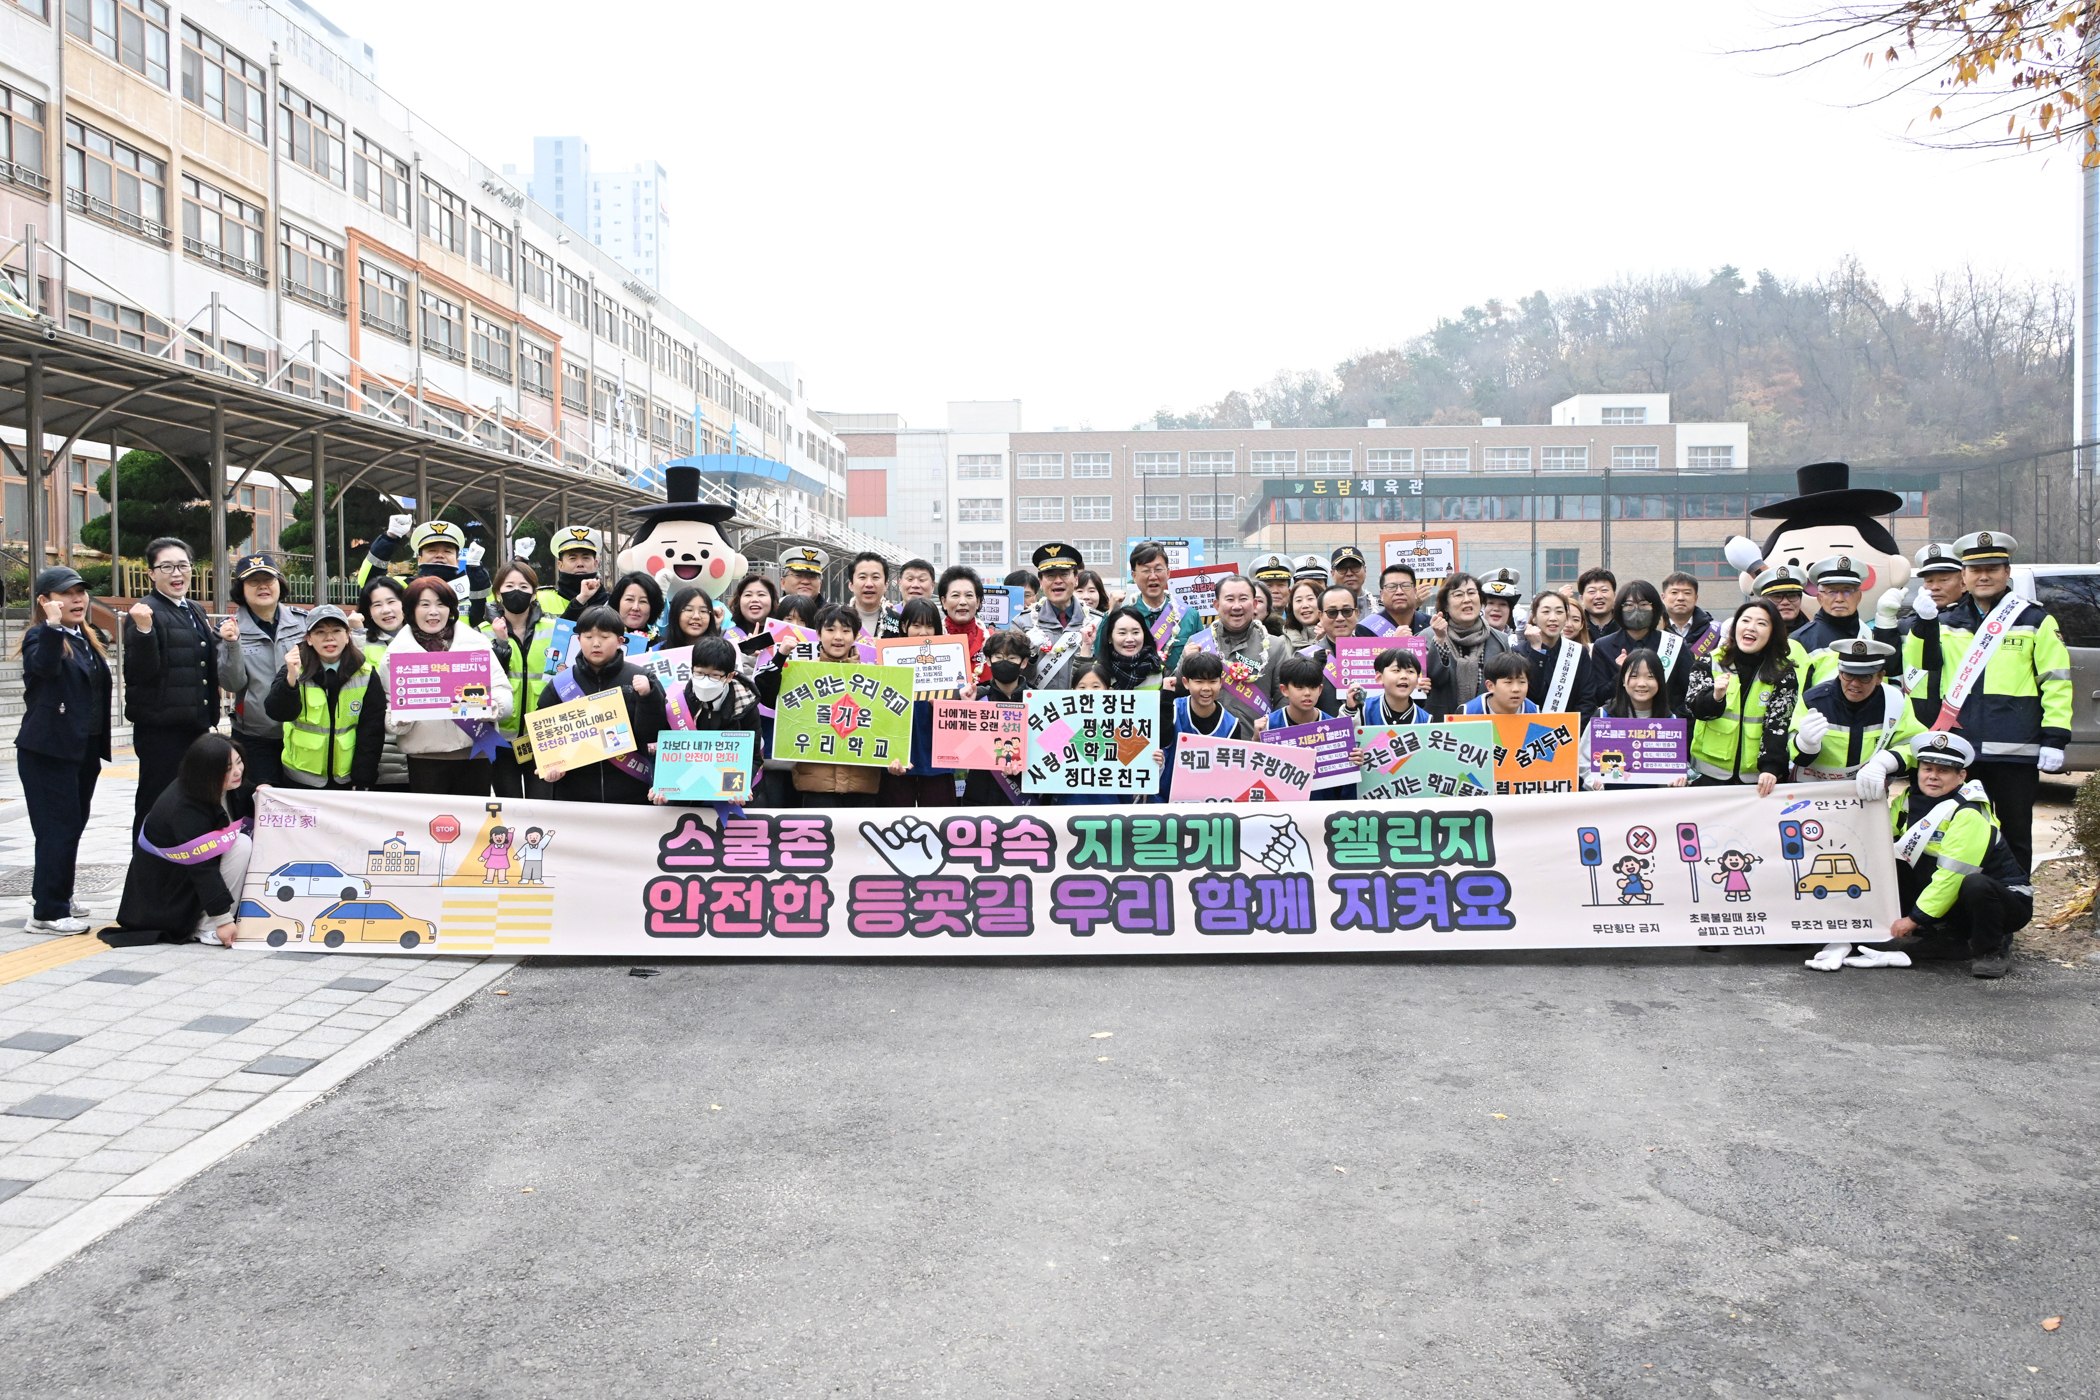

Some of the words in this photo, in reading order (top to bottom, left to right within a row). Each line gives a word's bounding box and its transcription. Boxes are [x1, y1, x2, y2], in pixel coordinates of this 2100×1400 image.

[1413, 548, 1429, 556] 약속
[916, 655, 935, 664] 약속
[1342, 648, 1371, 656] #스쿨존
[396, 665, 429, 674] #스쿨존
[431, 663, 450, 673] 약속
[452, 663, 477, 673] 챌린지
[781, 683, 815, 710] 폭력
[814, 675, 845, 698] 없는
[849, 674, 880, 700] 우리
[881, 686, 910, 717] 학교
[1102, 694, 1135, 714] 장난
[532, 717, 556, 730] 잠깐!
[559, 709, 586, 722] 복도는
[817, 705, 872, 728] 즐거운
[939, 708, 977, 719] 너에게는
[979, 709, 999, 720] 잠시
[1002, 710, 1022, 721] 장난
[535, 725, 573, 742] 운동장이
[576, 710, 617, 729] 아니에요!
[939, 720, 977, 731] 나에게는
[980, 721, 999, 732] 오랜
[1001, 722, 1021, 733] 상처
[538, 736, 567, 752] 천천히
[570, 727, 599, 743] 걸어요
[1298, 732, 1326, 746] 지킬게
[1326, 729, 1350, 741] 챌린지
[1595, 730, 1626, 739] #스쿨존
[1628, 729, 1656, 739] 지킬게
[1657, 730, 1682, 739] 챌린지
[662, 741, 691, 751] 차보다
[693, 741, 712, 751] 내가
[715, 741, 740, 751] 먼저?
[1389, 732, 1421, 758] 얼굴
[1428, 730, 1458, 753] 웃는
[1458, 743, 1489, 769] 인사
[1515, 724, 1573, 768] 숨겨두면
[661, 753, 682, 763] NO!
[684, 753, 713, 763] 안전이
[716, 753, 739, 763] 먼저!
[1028, 743, 1079, 785] 사랑의
[1084, 742, 1118, 762] 학교
[1181, 750, 1210, 770] 학교
[1216, 748, 1246, 768] 폭력
[1065, 767, 1113, 788] 정다운
[1118, 768, 1151, 788] 친구
[1428, 773, 1458, 796] 학교
[1814, 799, 1865, 811] 안산시
[259, 814, 297, 828] 안전한
[300, 815, 317, 829] 家!
[1804, 825, 1819, 835] 30
[657, 813, 836, 873] 스쿨존
[943, 815, 1057, 873] 약속
[1068, 812, 1241, 872] 지킬게
[1325, 810, 1496, 870] 챌린지
[643, 873, 835, 938] 안전한
[847, 873, 1035, 938] 등굣길
[1051, 873, 1175, 936] 우리
[1191, 871, 1317, 935] 함께
[1329, 870, 1516, 933] 지켜요
[1689, 912, 1743, 924] 초록불일때
[1746, 911, 1768, 923] 좌우
[1791, 920, 1824, 931] 무조건
[1826, 919, 1849, 931] 일단
[1851, 918, 1873, 930] 정지
[1592, 923, 1637, 934] 무단횡단
[1639, 923, 1660, 933] 금지
[1697, 925, 1730, 936] 살피고
[1732, 925, 1765, 936] 건너기
